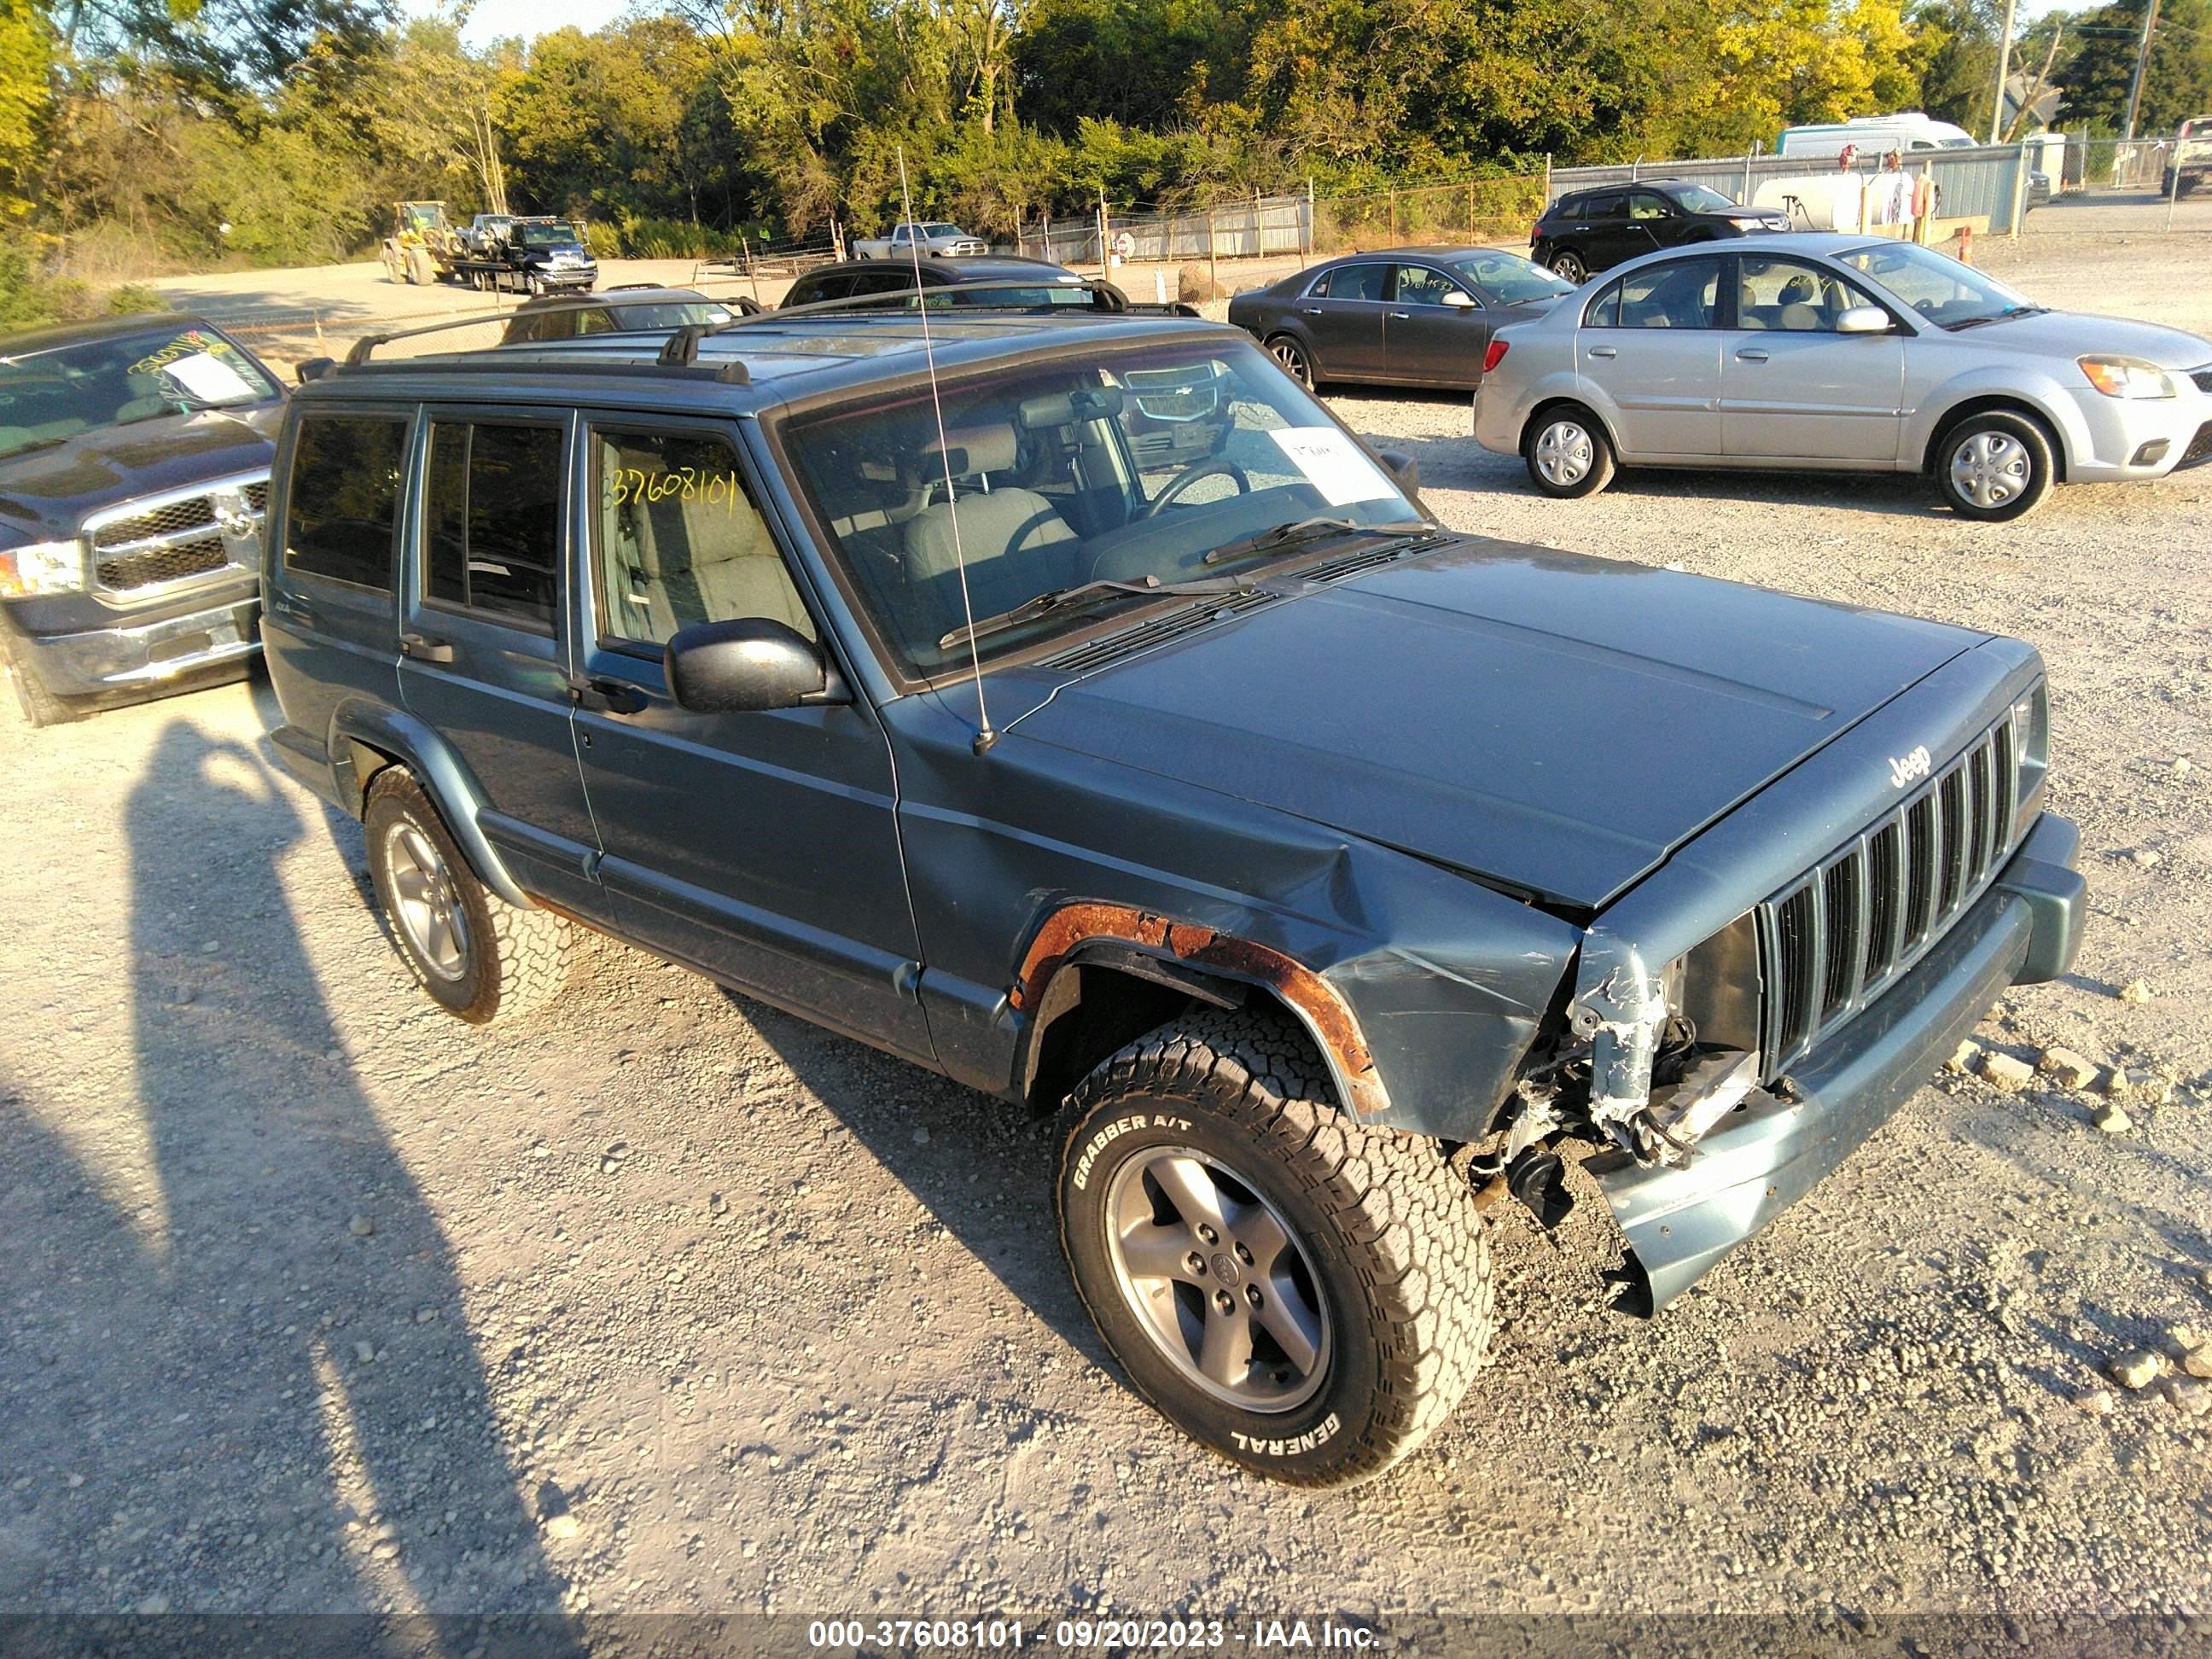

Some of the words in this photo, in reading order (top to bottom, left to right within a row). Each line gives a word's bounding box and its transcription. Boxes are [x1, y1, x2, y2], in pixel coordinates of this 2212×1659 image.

[611, 467, 736, 519] 37608101
[1888, 745, 1931, 789] Jeep
[1073, 1115, 1147, 1190] GRABBER
[1154, 1115, 1192, 1132] A/T
[1230, 1412, 1342, 1457] GENERAL
